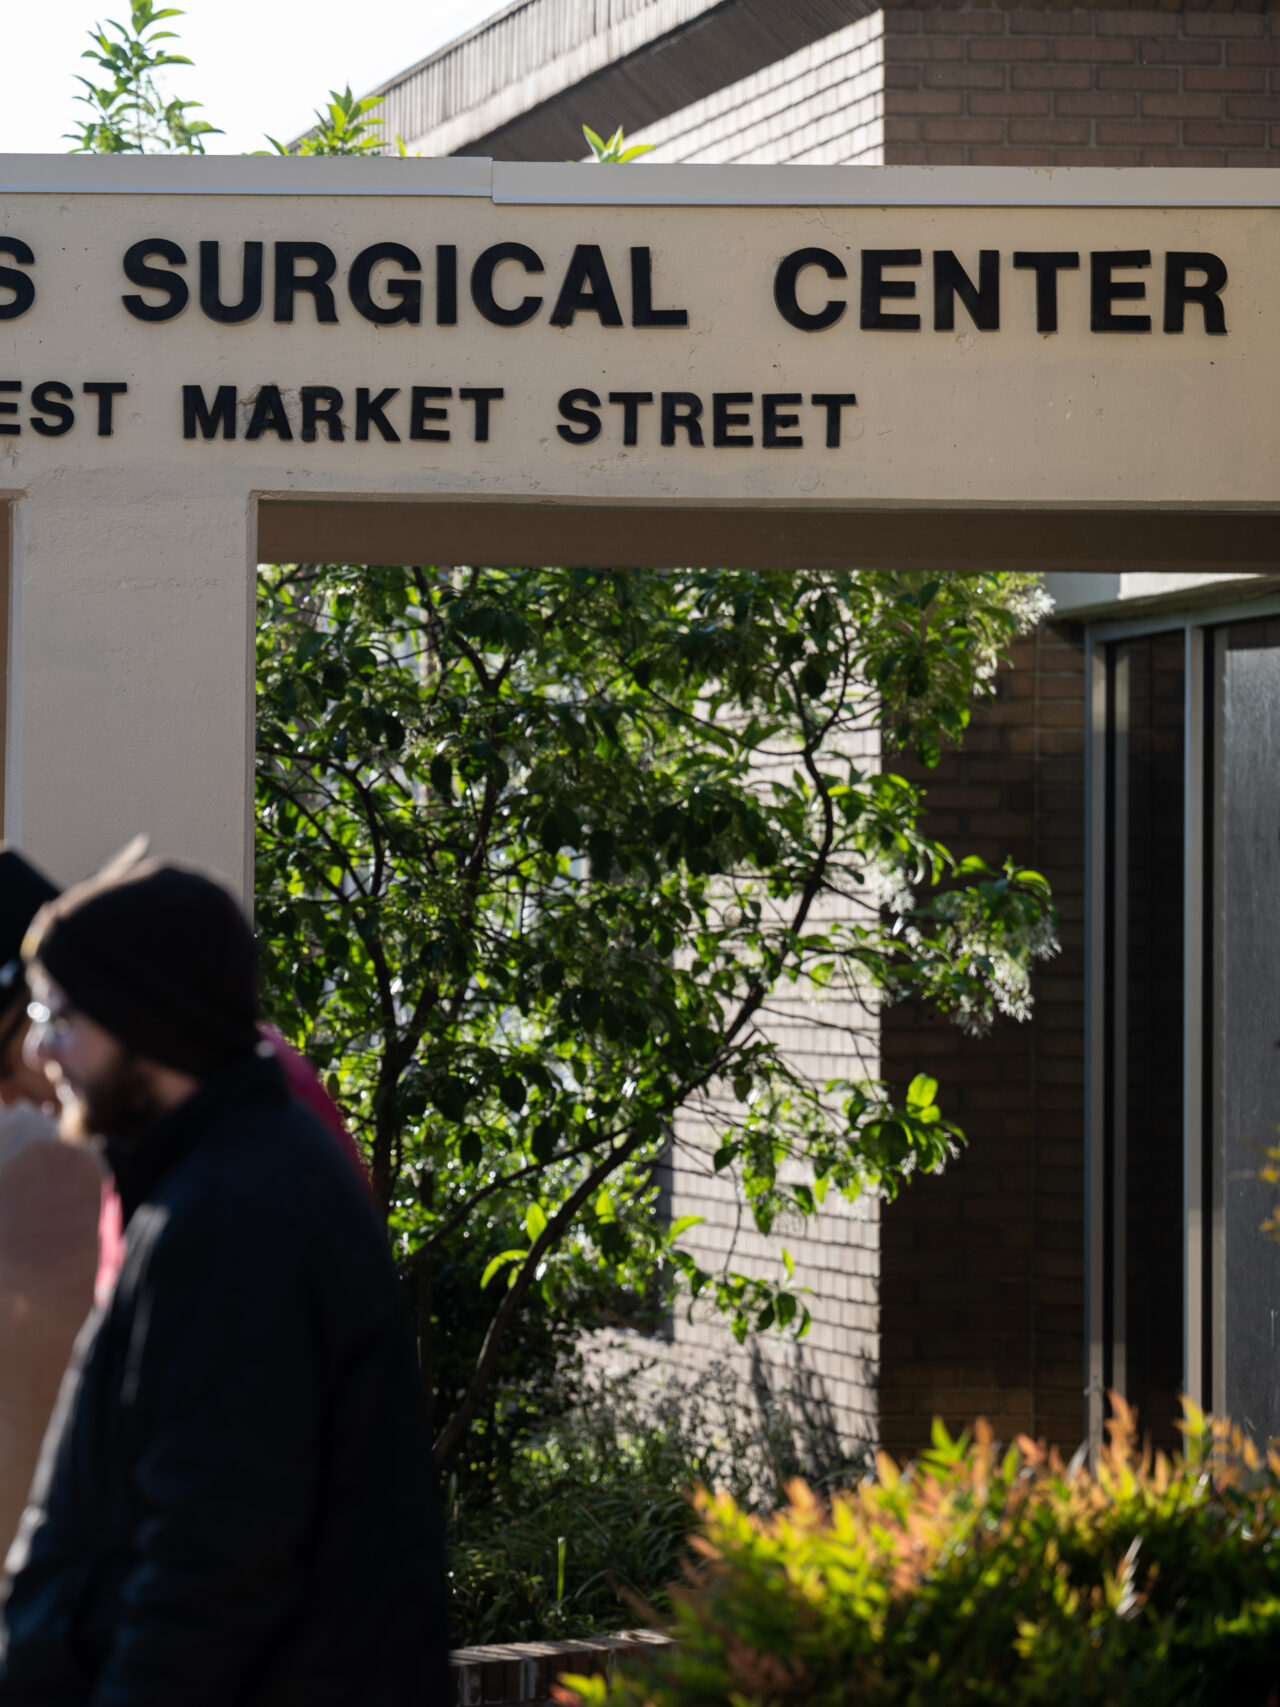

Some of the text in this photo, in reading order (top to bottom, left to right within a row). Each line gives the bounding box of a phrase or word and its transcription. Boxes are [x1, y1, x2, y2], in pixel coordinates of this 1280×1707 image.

[121, 235, 689, 329] SURGICAL
[773, 247, 1229, 336] CENTER
[182, 384, 505, 444] MARKET
[556, 387, 857, 450] STREET
